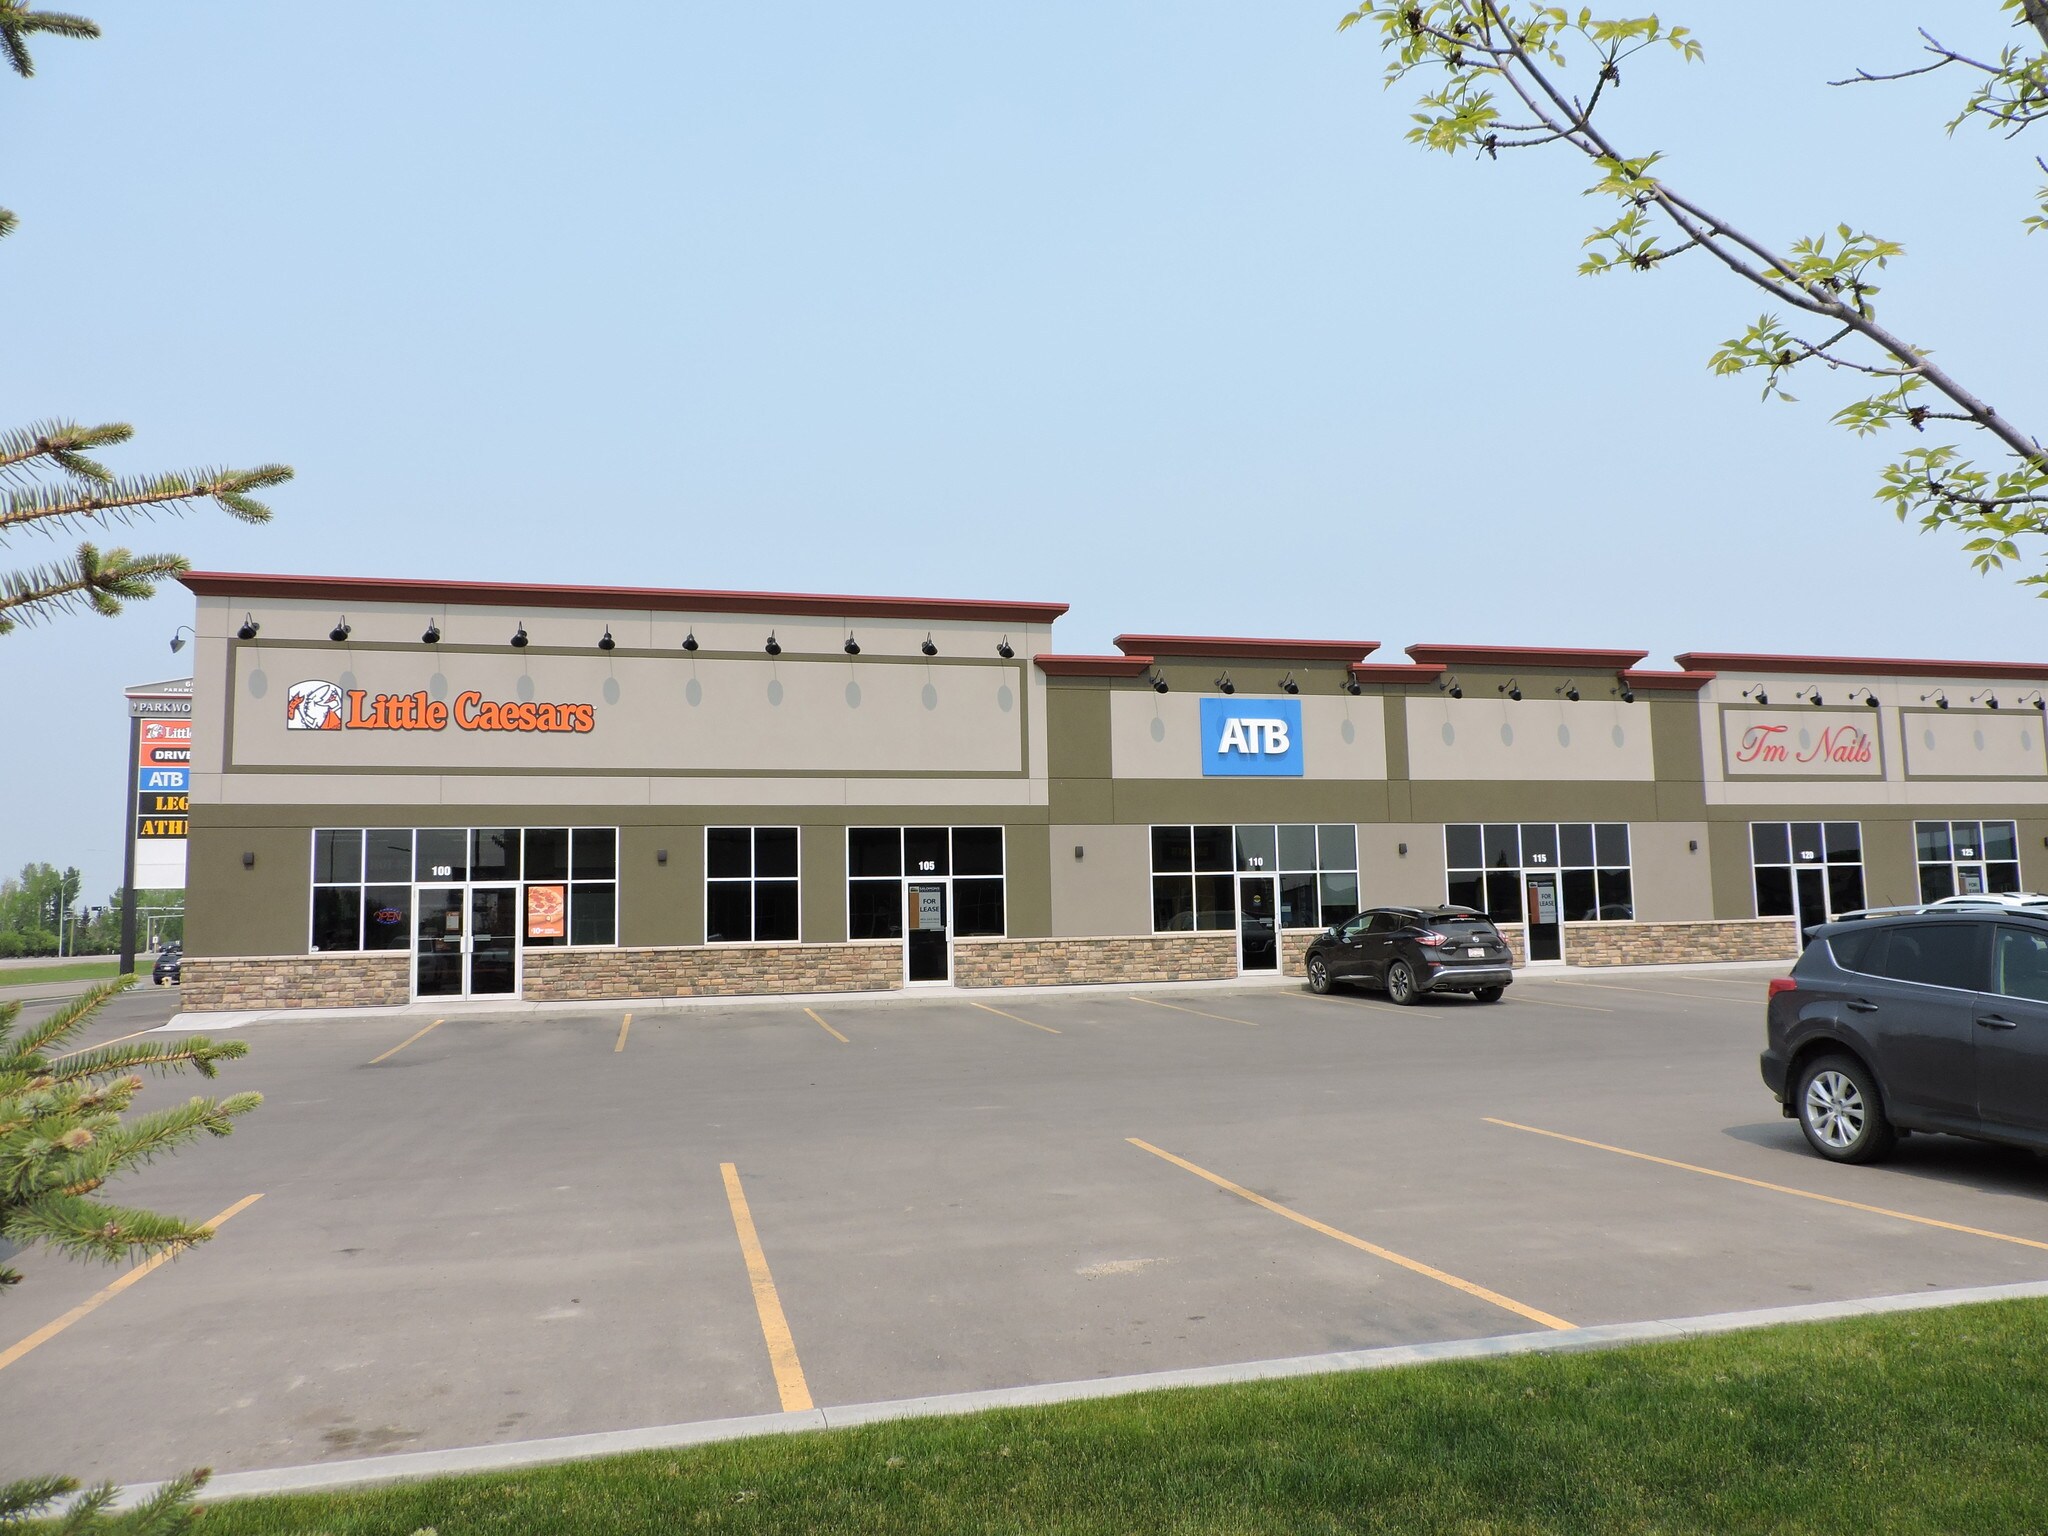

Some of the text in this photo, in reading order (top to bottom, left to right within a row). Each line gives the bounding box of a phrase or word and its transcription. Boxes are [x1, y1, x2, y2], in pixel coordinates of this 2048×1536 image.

[346, 690, 594, 732] Little Caesars
[165, 726, 191, 738] Littl
[1218, 718, 1290, 754] ATB
[1736, 725, 1871, 762] Tm Nails
[149, 772, 183, 786] ATB
[156, 797, 188, 810] LEG
[1801, 851, 1815, 859] 120
[1962, 848, 1974, 856] 125
[1248, 858, 1263, 866] 110
[1533, 854, 1547, 862] 115
[919, 861, 935, 870] 105
[432, 866, 451, 875] 100
[373, 911, 402, 920] OPEN
